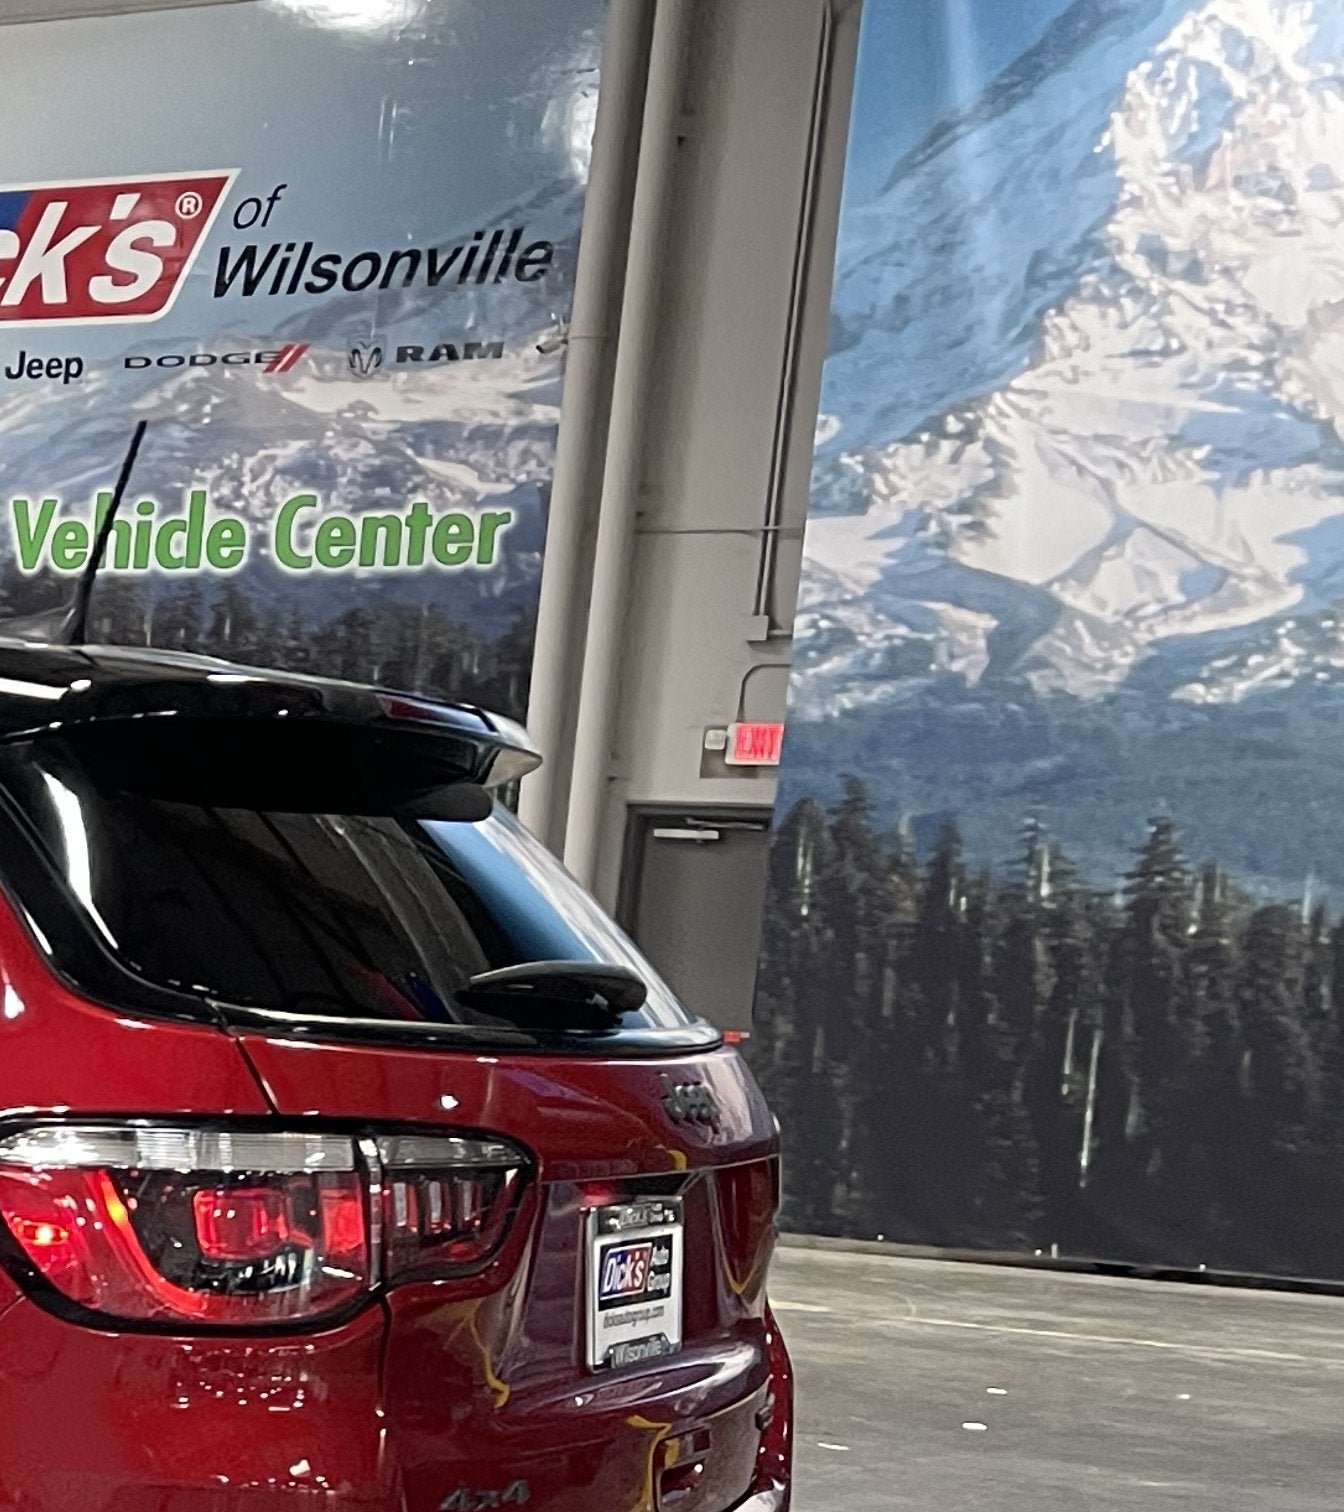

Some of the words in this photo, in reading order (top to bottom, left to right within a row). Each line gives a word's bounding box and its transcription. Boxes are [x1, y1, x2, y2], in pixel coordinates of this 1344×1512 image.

[233, 184, 287, 230] of
[213, 227, 554, 298] Wilsonville
[5, 350, 84, 385] Jeep
[123, 350, 282, 371] DODGE
[395, 341, 506, 363] RAM
[12, 489, 248, 571] Vehicle
[274, 493, 512, 570] Center
